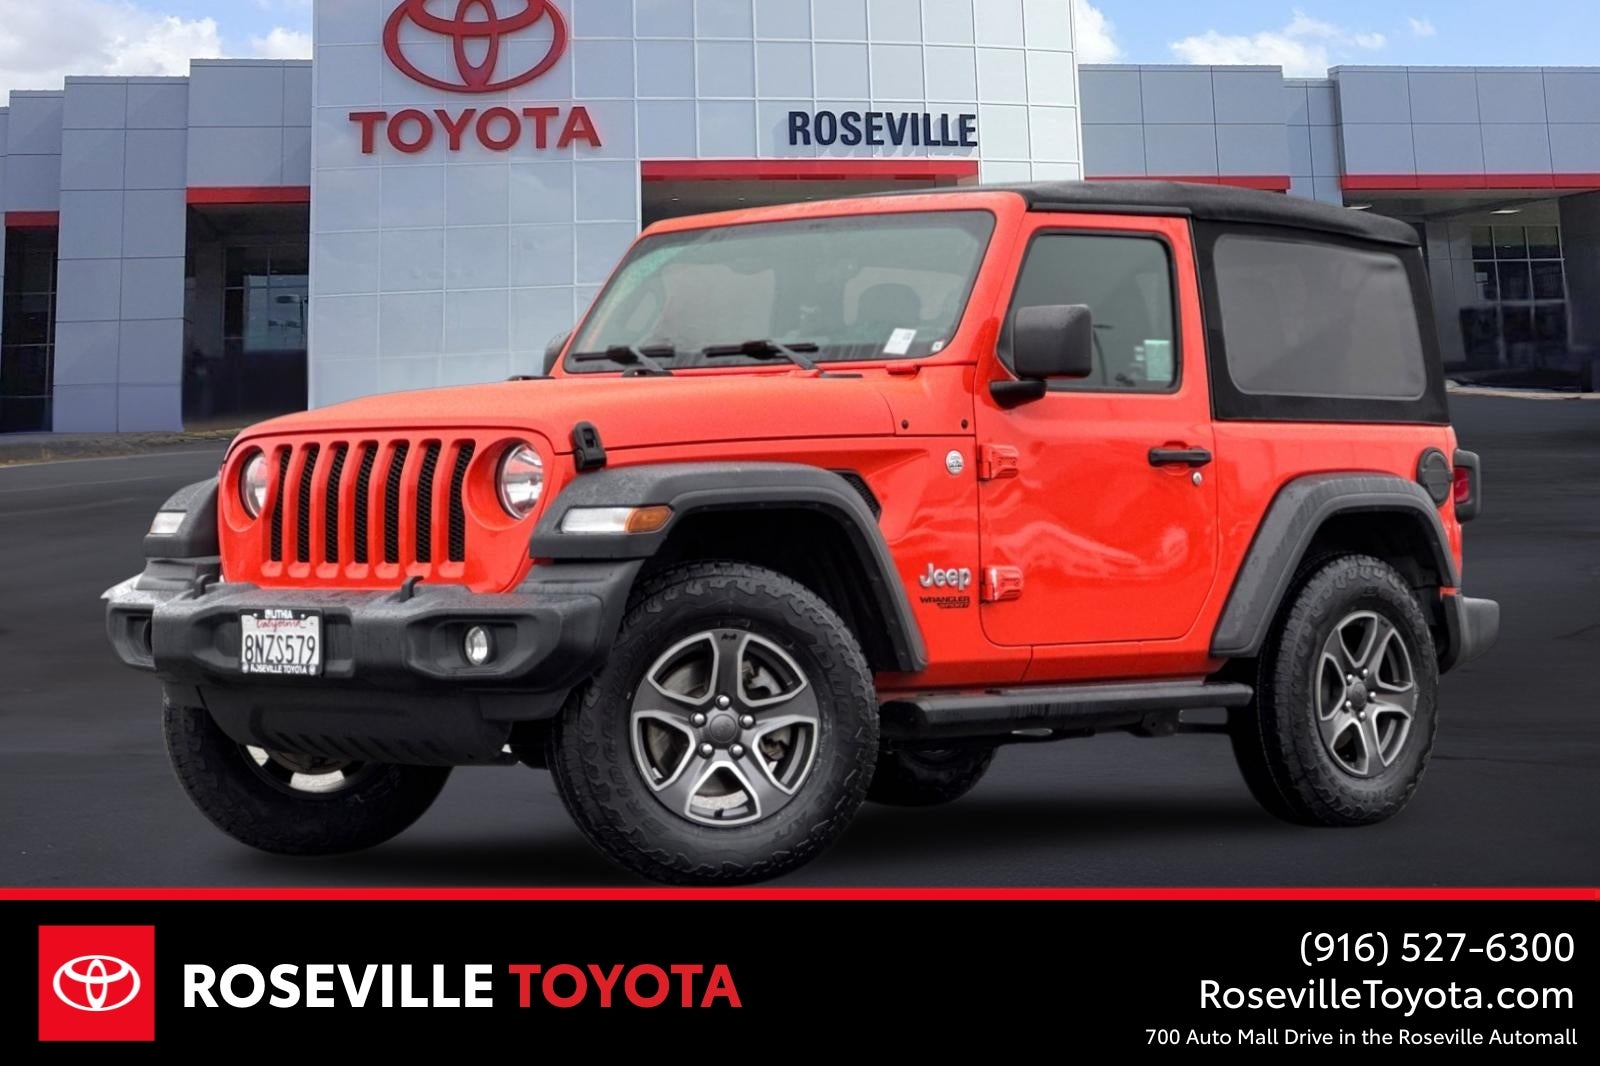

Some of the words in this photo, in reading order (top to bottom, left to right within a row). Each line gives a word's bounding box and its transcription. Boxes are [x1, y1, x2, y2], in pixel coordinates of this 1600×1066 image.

[349, 106, 602, 154] TOYOTA
[788, 111, 978, 147] ROSEVILLE
[919, 562, 971, 591] Jeep
[245, 634, 316, 664] 8NZS579
